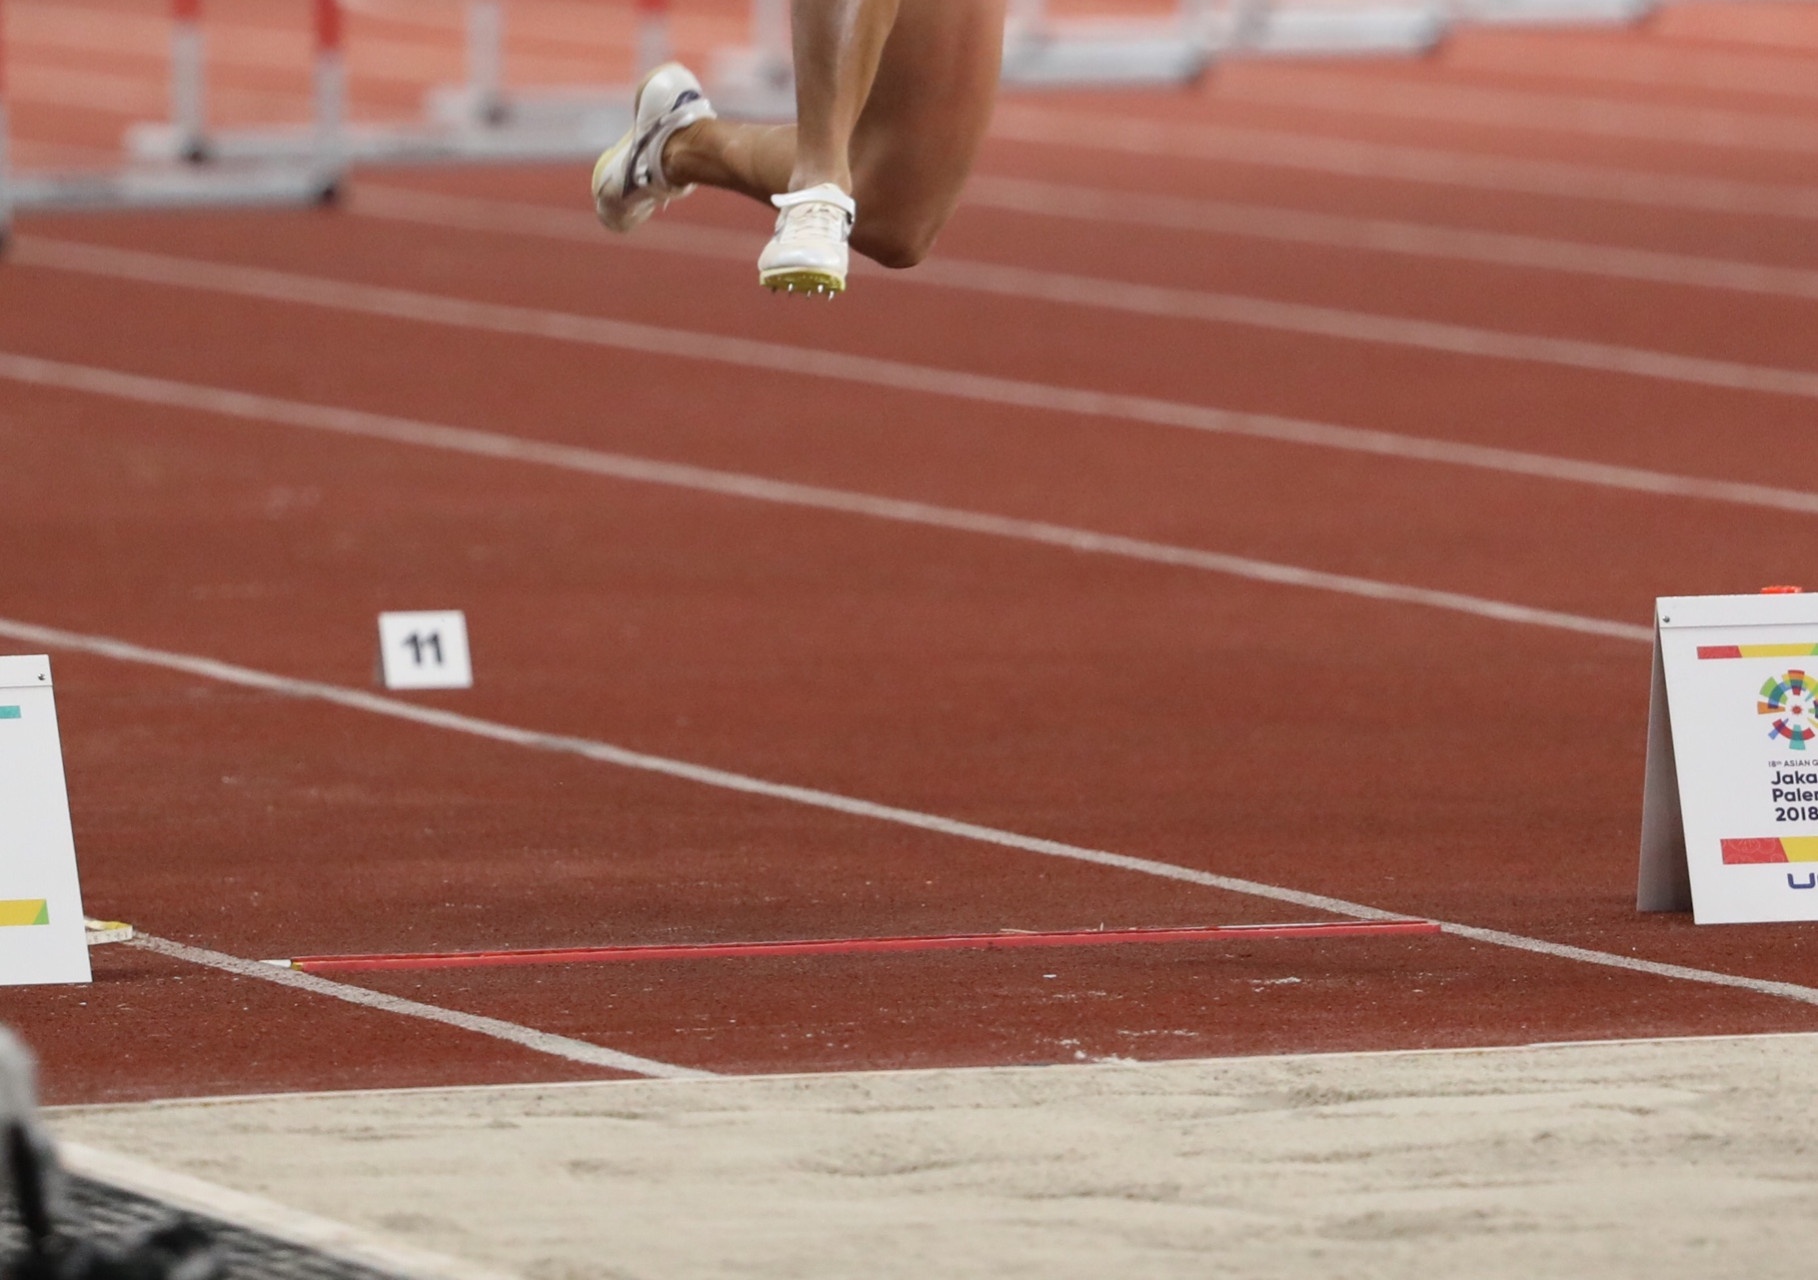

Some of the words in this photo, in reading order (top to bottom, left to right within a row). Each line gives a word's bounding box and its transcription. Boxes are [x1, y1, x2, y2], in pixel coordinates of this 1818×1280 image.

[401, 631, 443, 665] 11
[1772, 787, 1818, 802] Pale
[1775, 806, 1818, 821] 2018
